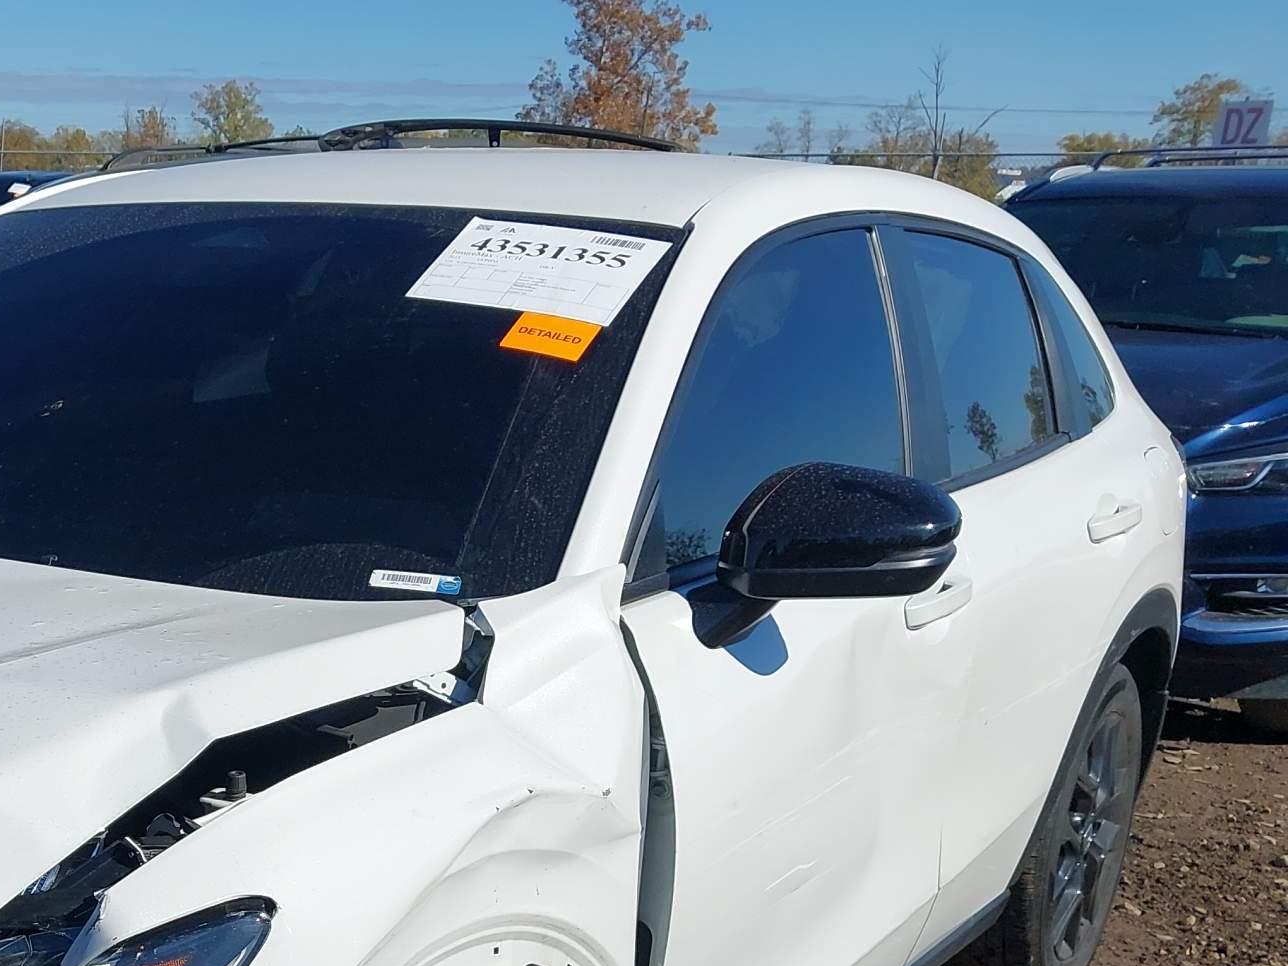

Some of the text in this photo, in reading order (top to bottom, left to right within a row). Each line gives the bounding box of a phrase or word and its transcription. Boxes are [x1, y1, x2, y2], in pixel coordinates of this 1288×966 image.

[1220, 107, 1265, 145] DZ
[470, 236, 632, 269] 43531355
[517, 325, 583, 345] DETAILED
